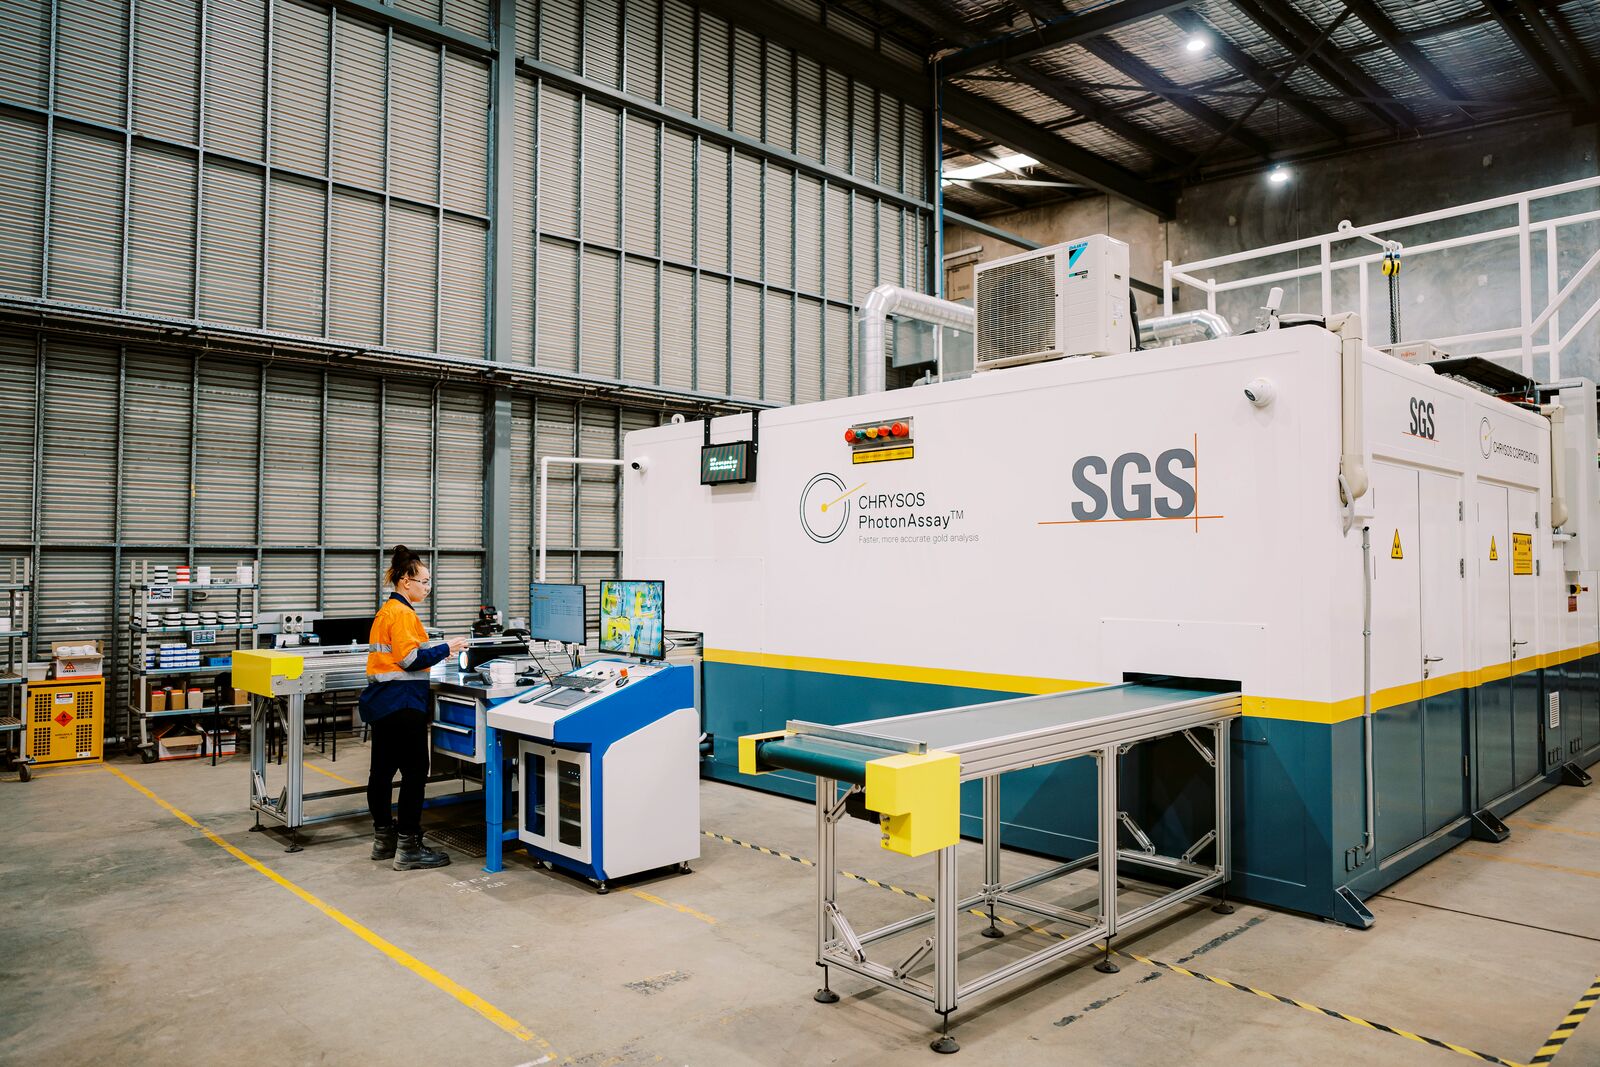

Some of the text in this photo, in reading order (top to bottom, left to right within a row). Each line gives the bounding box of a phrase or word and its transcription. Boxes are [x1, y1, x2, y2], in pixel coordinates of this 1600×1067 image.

[1068, 241, 1088, 250] DAIKIN
[1409, 396, 1435, 440] SGS
[1492, 441, 1539, 464] CHRYSOS CORPORATION
[1071, 448, 1196, 521] SGS
[858, 492, 925, 509] CHRYSOS
[858, 535, 880, 544] Faster,
[900, 535, 931, 543] accurate
[932, 533, 948, 544] gold
[950, 533, 979, 543] analysis
